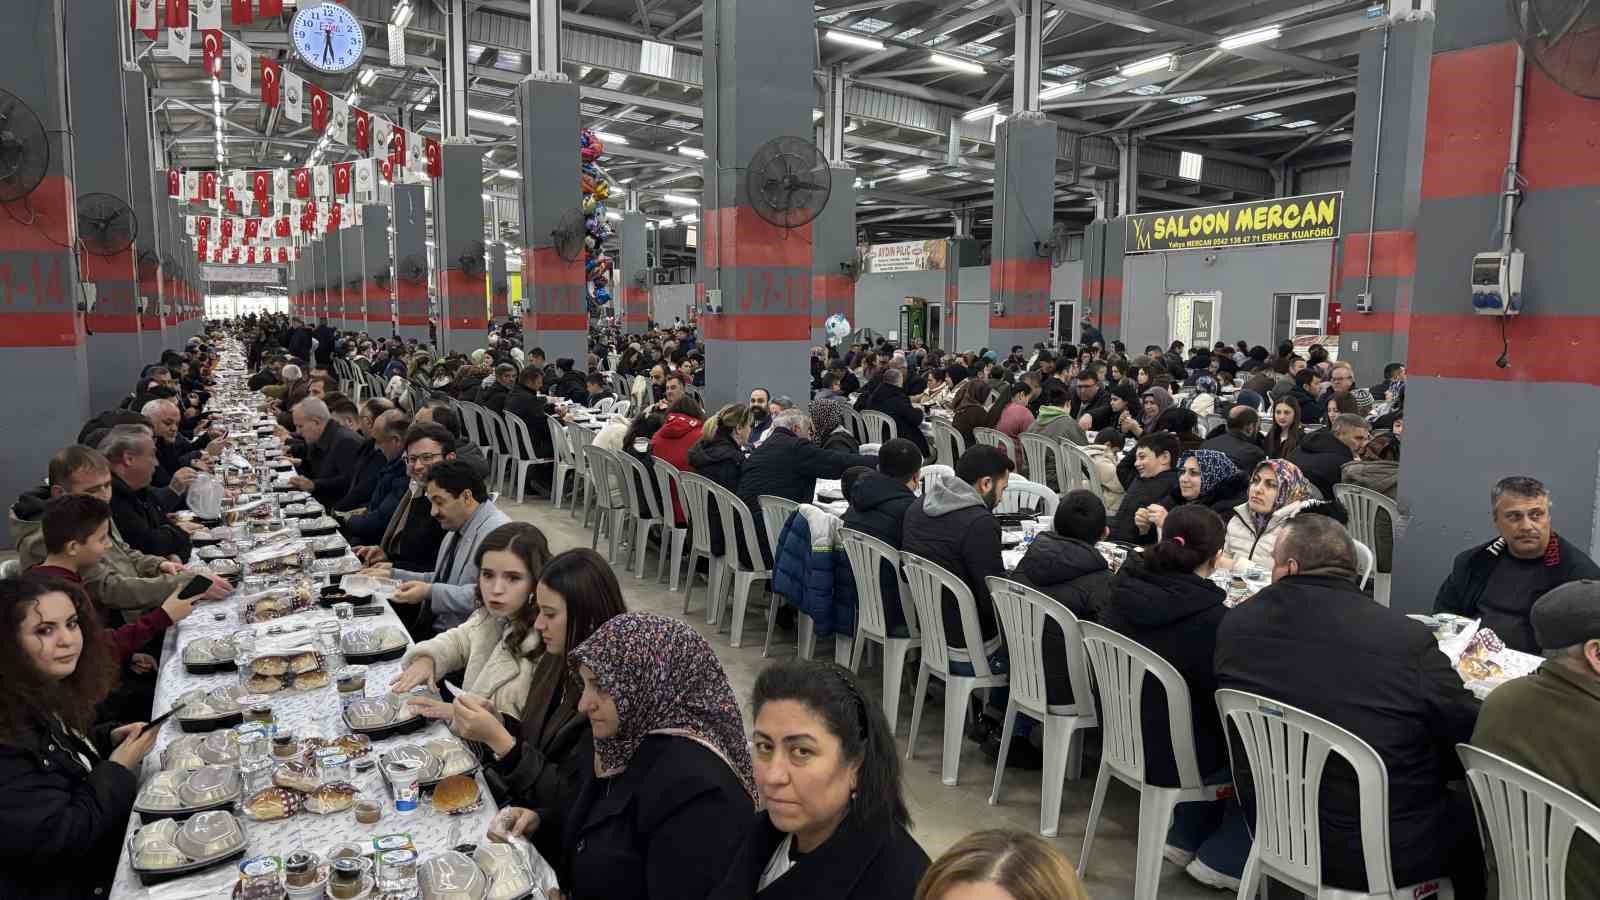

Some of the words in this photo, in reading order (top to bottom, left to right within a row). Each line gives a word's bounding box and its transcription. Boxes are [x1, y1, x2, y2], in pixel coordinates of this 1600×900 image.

[311, 12, 319, 20] 11
[339, 15, 343, 23] 1
[346, 25, 352, 33] 2
[305, 43, 310, 51] 8
[1154, 209, 1230, 240] SALOON
[1235, 197, 1336, 232] MERCAN
[1187, 239, 1212, 247] MERCAN
[1262, 231, 1290, 241] ERKEK
[1291, 226, 1333, 239] KUAFÖRÜ
